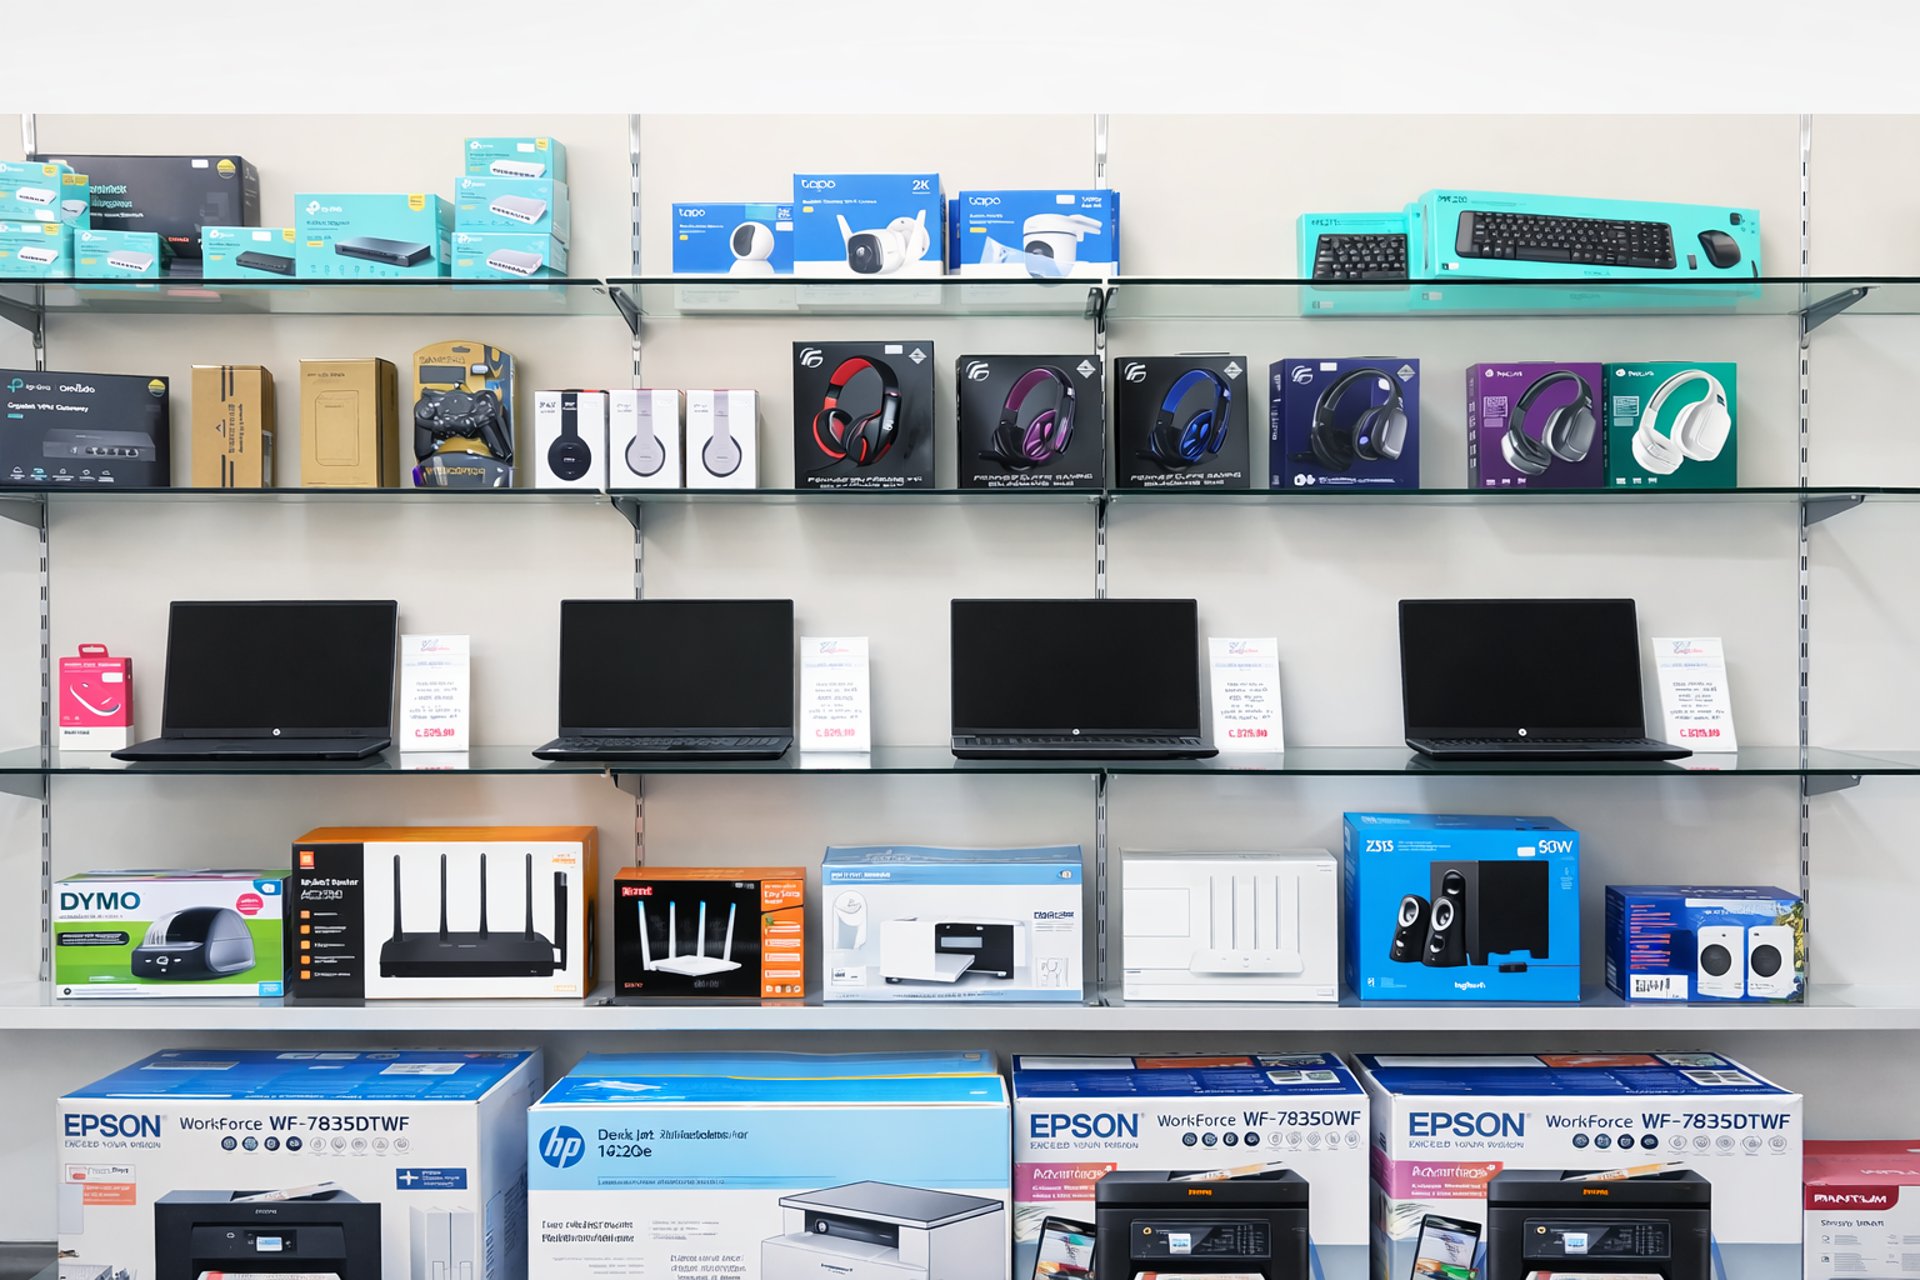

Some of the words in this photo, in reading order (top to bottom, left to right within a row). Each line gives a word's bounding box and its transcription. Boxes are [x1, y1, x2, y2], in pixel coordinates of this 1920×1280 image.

[912, 179, 931, 191] 2K
[969, 197, 1001, 207] tapo
[60, 891, 141, 911] DYMO
[64, 1113, 161, 1138] EPSON
[180, 1117, 263, 1131] WorkForce
[269, 1115, 410, 1132] WF-7835DTWF
[1030, 1113, 1138, 1138] EPSON
[1157, 1114, 1236, 1127] WorkForce
[1409, 1112, 1525, 1137] EPSON
[1546, 1114, 1633, 1129] WorkForce
[1641, 1113, 1791, 1130] WF-7835DTWF
[544, 1126, 583, 1168] hp
